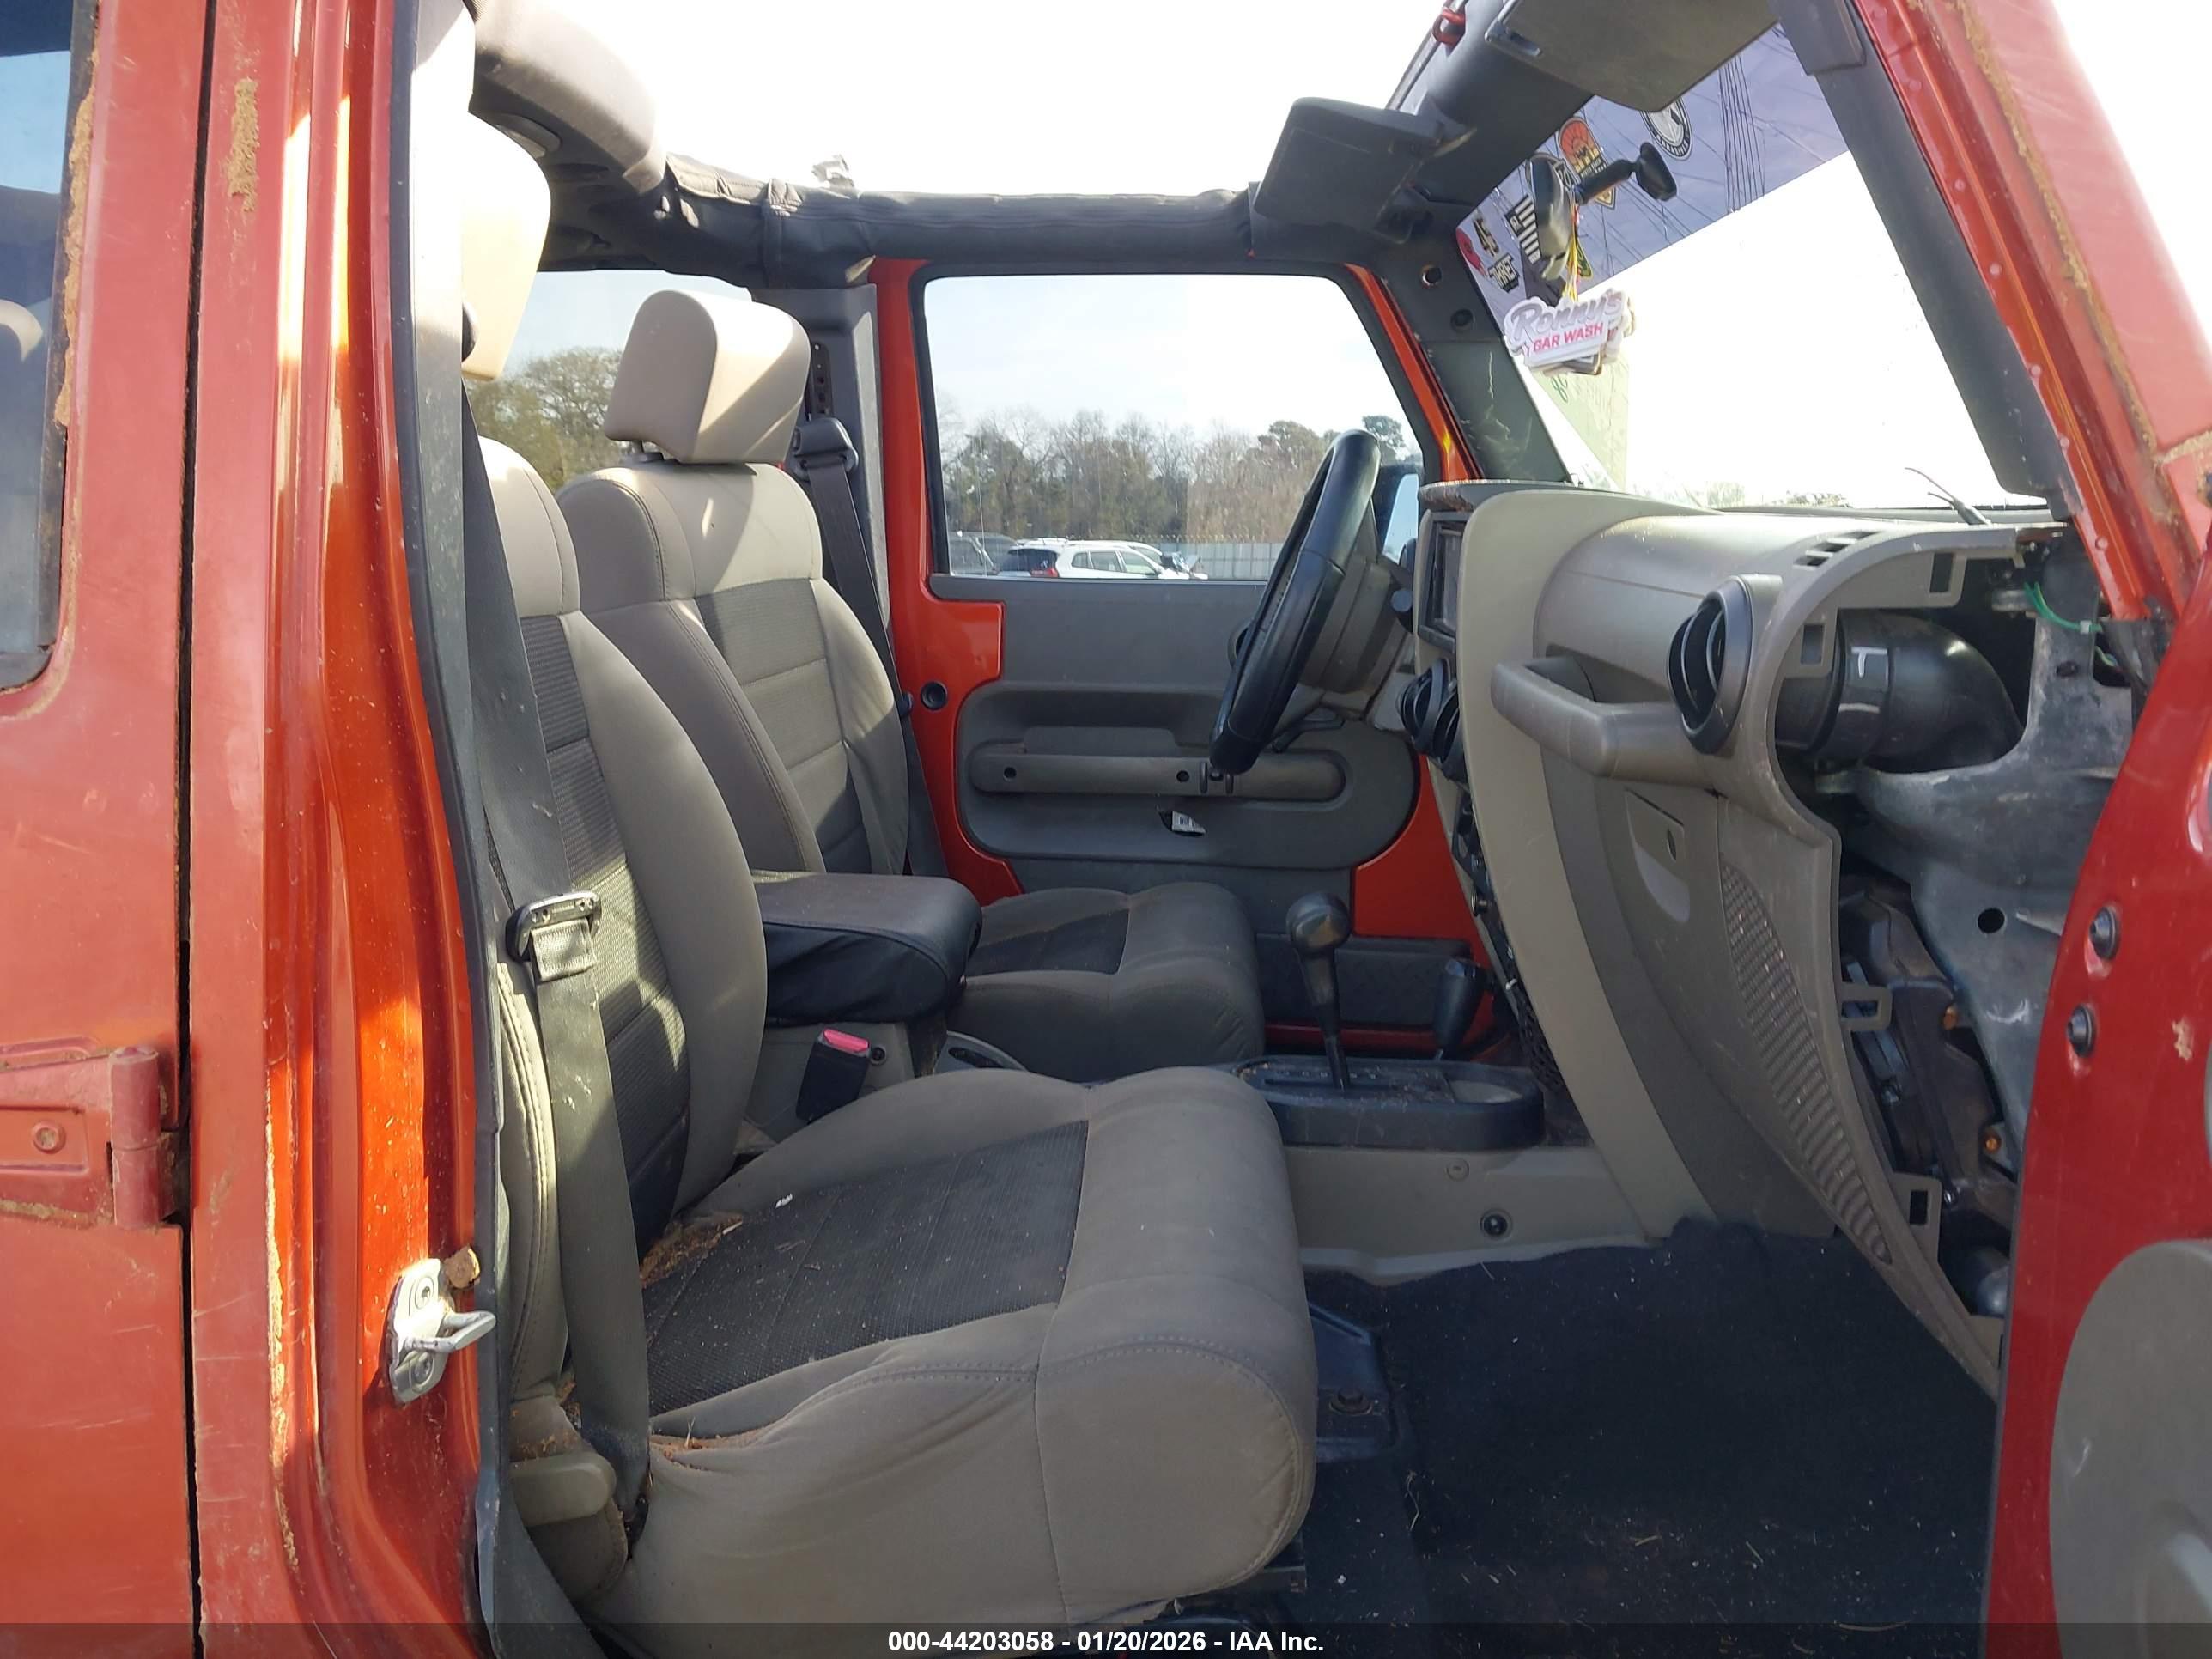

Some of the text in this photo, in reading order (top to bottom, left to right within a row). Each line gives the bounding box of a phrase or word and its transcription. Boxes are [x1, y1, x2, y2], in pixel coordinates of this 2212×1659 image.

[1510, 289, 1622, 343] Ronny's
[1532, 334, 1560, 353] CAR
[1564, 322, 1603, 342] WASH
